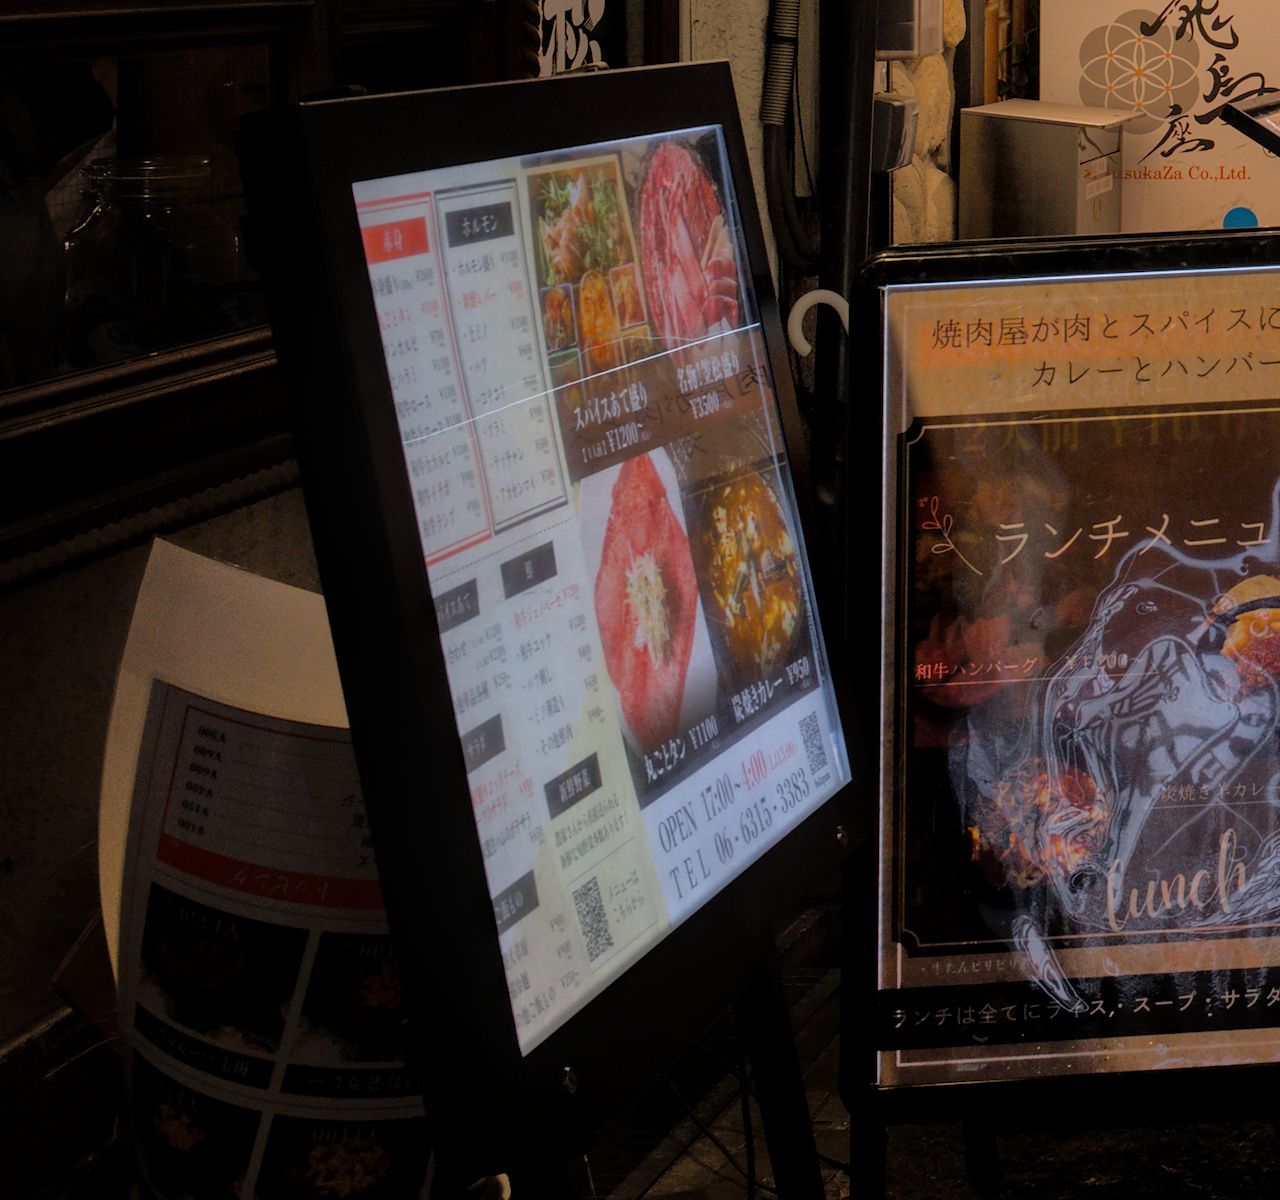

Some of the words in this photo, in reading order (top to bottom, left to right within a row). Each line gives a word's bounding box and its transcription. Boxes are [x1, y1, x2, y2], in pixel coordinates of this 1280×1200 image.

[1188, 166, 1251, 181] Co.,Ltd.
[462, 215, 498, 238] ホルモン
[688, 714, 720, 750] ¥1100
[657, 801, 699, 854] OPEN
[669, 849, 712, 900] TEL
